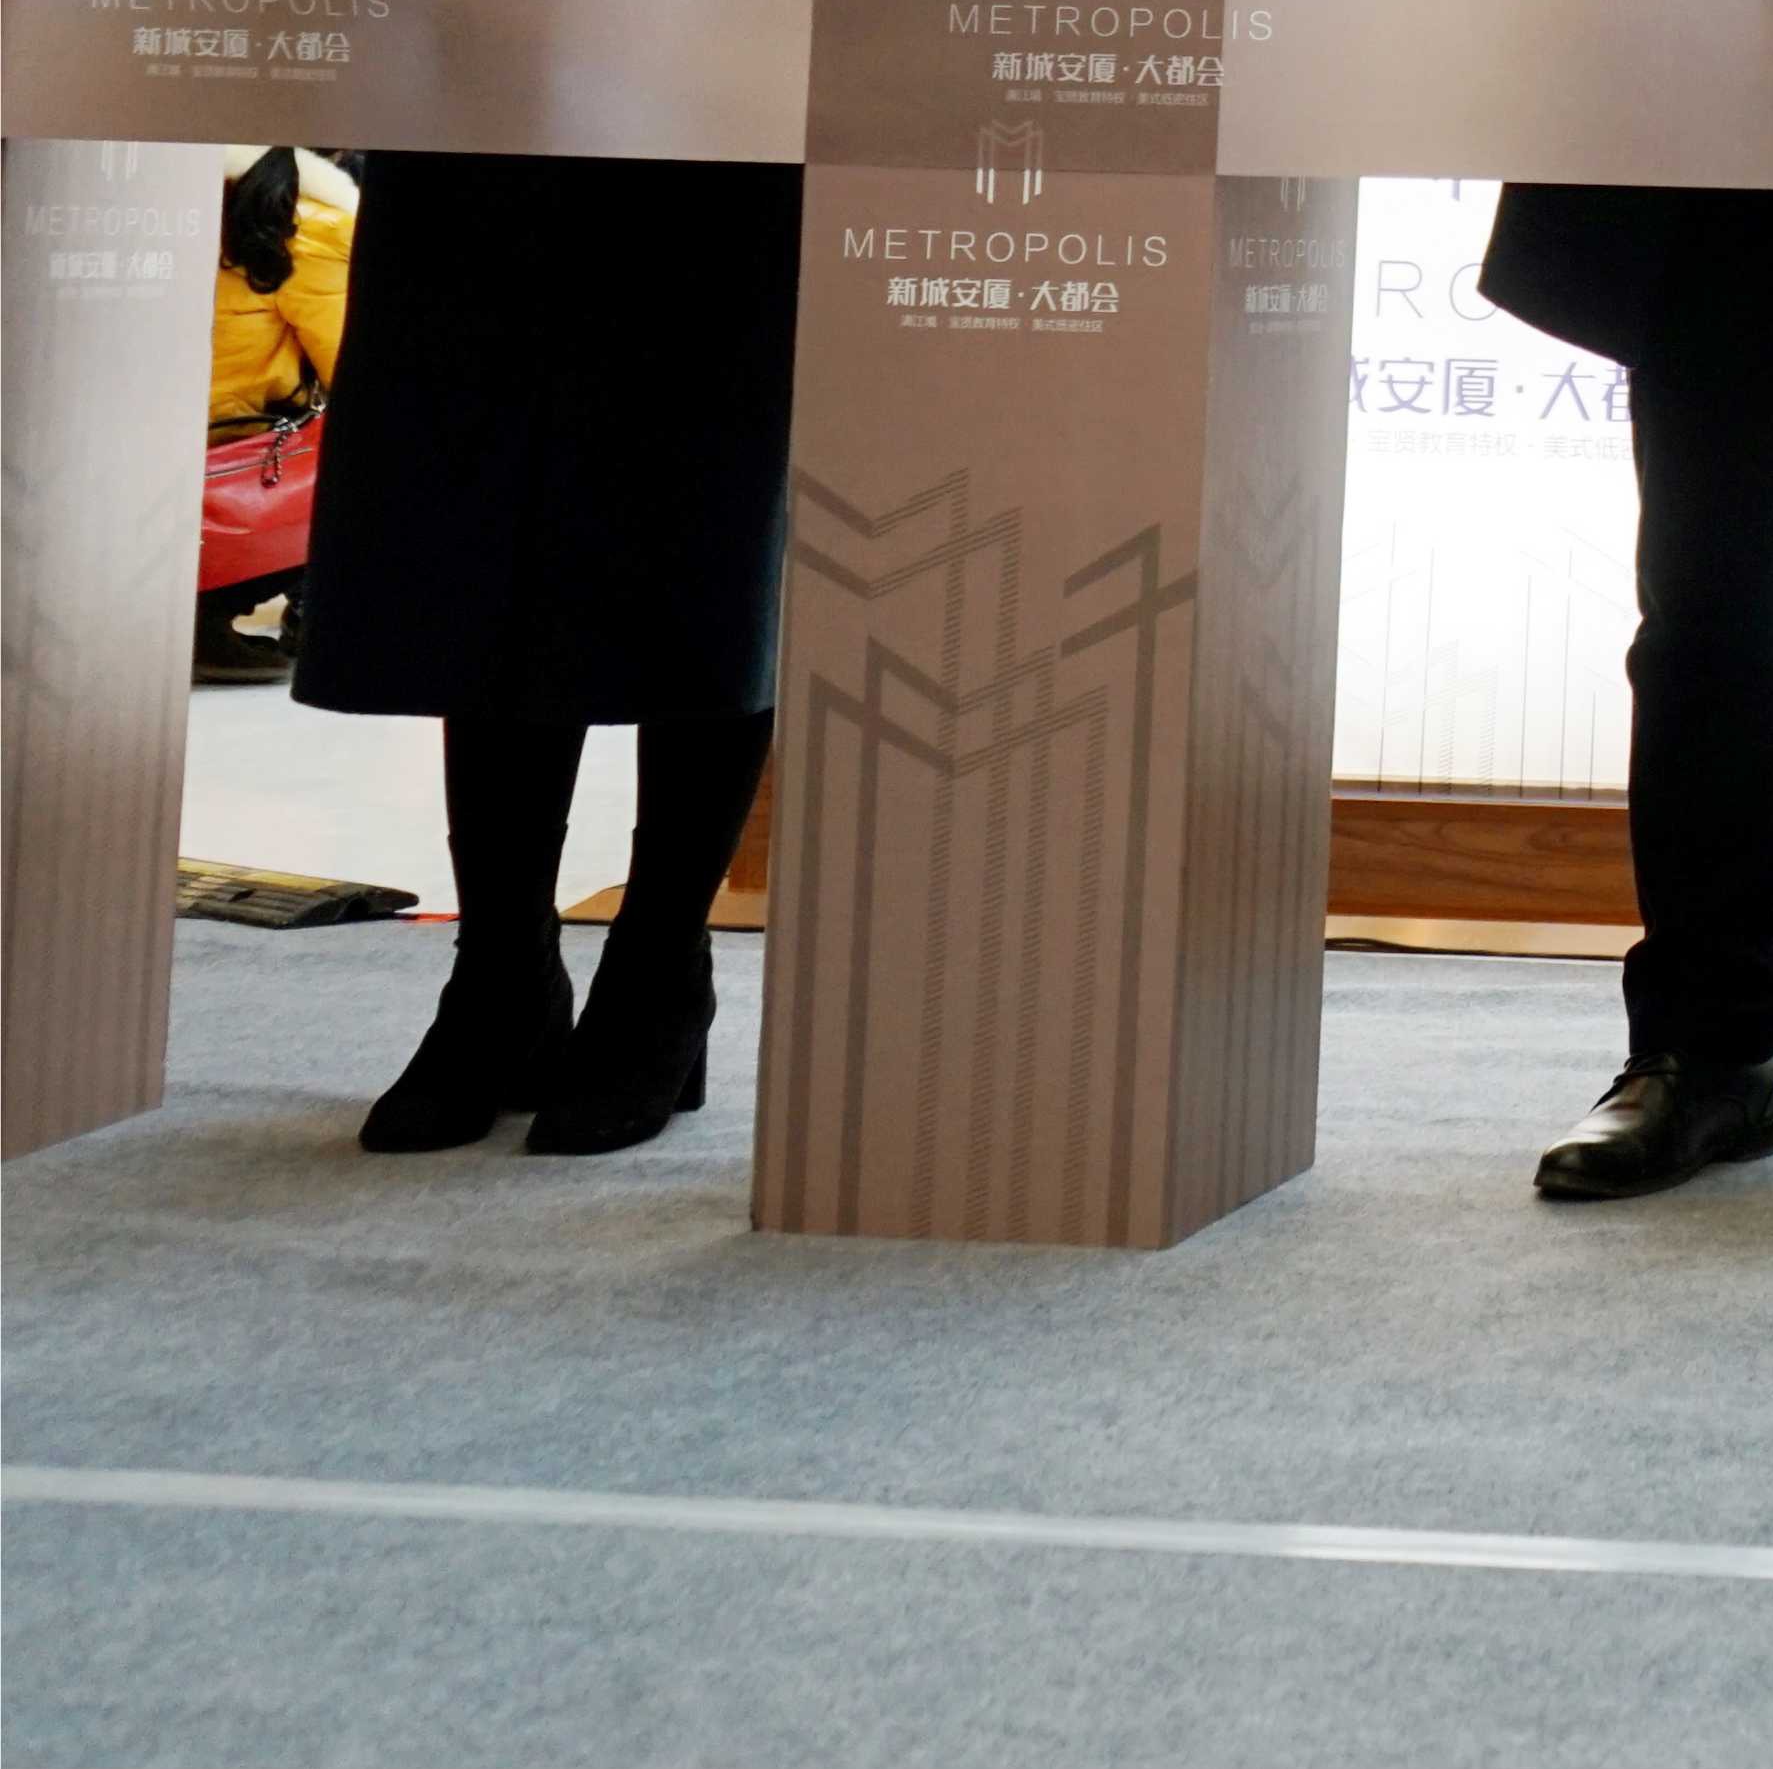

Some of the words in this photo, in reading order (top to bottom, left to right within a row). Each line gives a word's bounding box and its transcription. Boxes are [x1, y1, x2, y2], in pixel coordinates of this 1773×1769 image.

[948, 3, 1275, 42] METROPOLIS
[991, 52, 1226, 88] 新城安厦·大都会
[842, 227, 1170, 269] METROPOLIS
[886, 276, 1120, 315] 新城安厦·大都会
